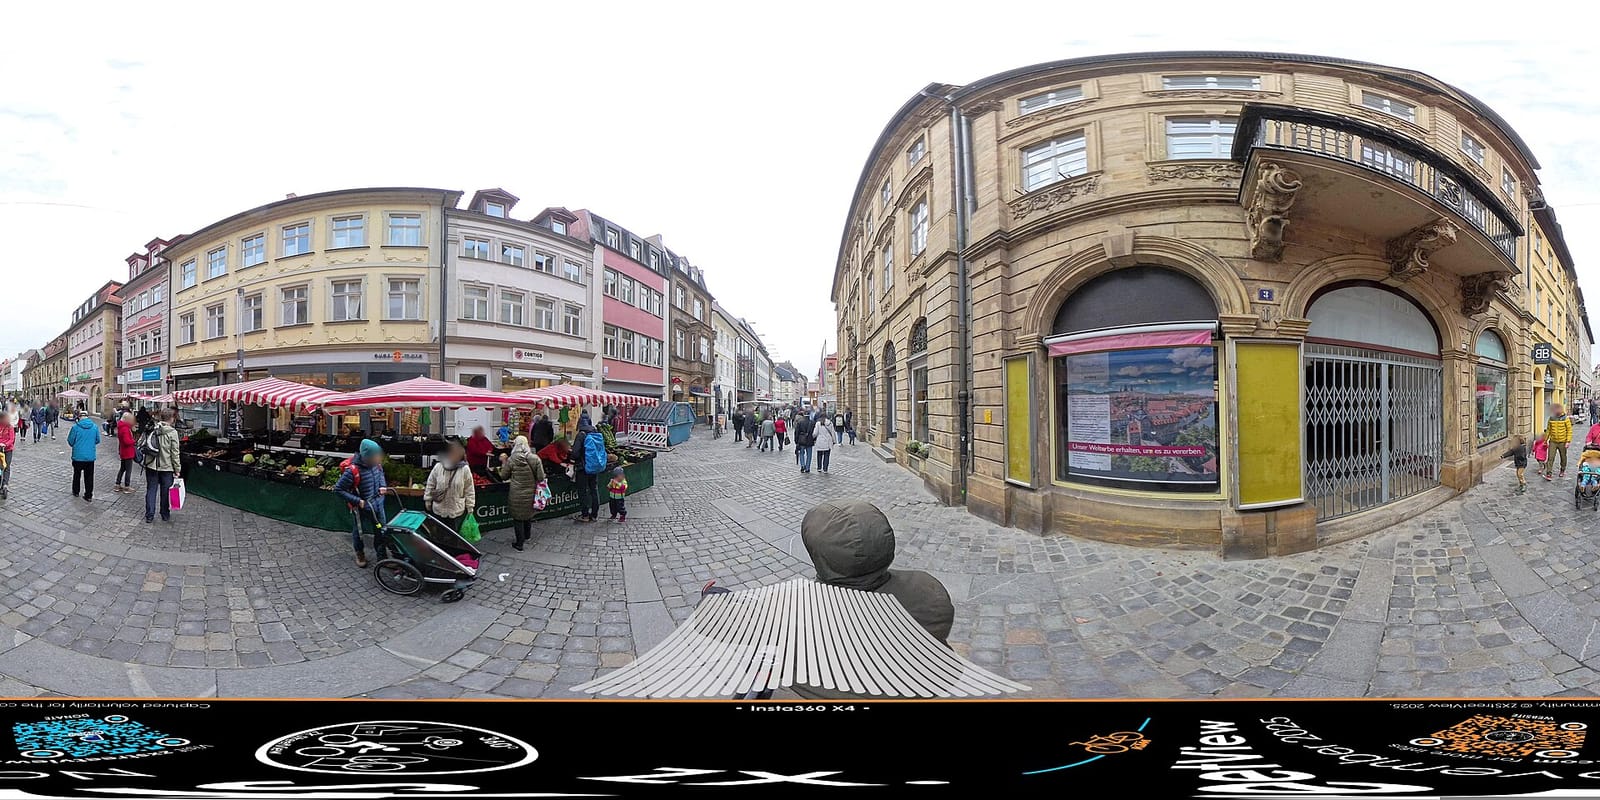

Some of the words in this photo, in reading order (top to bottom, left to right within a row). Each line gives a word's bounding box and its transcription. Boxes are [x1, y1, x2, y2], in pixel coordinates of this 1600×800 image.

[1072, 443, 1088, 451] Unser
[1116, 446, 1142, 454] erhalten,
[476, 504, 508, 518] Gärt
[546, 490, 578, 506] ichfeld
